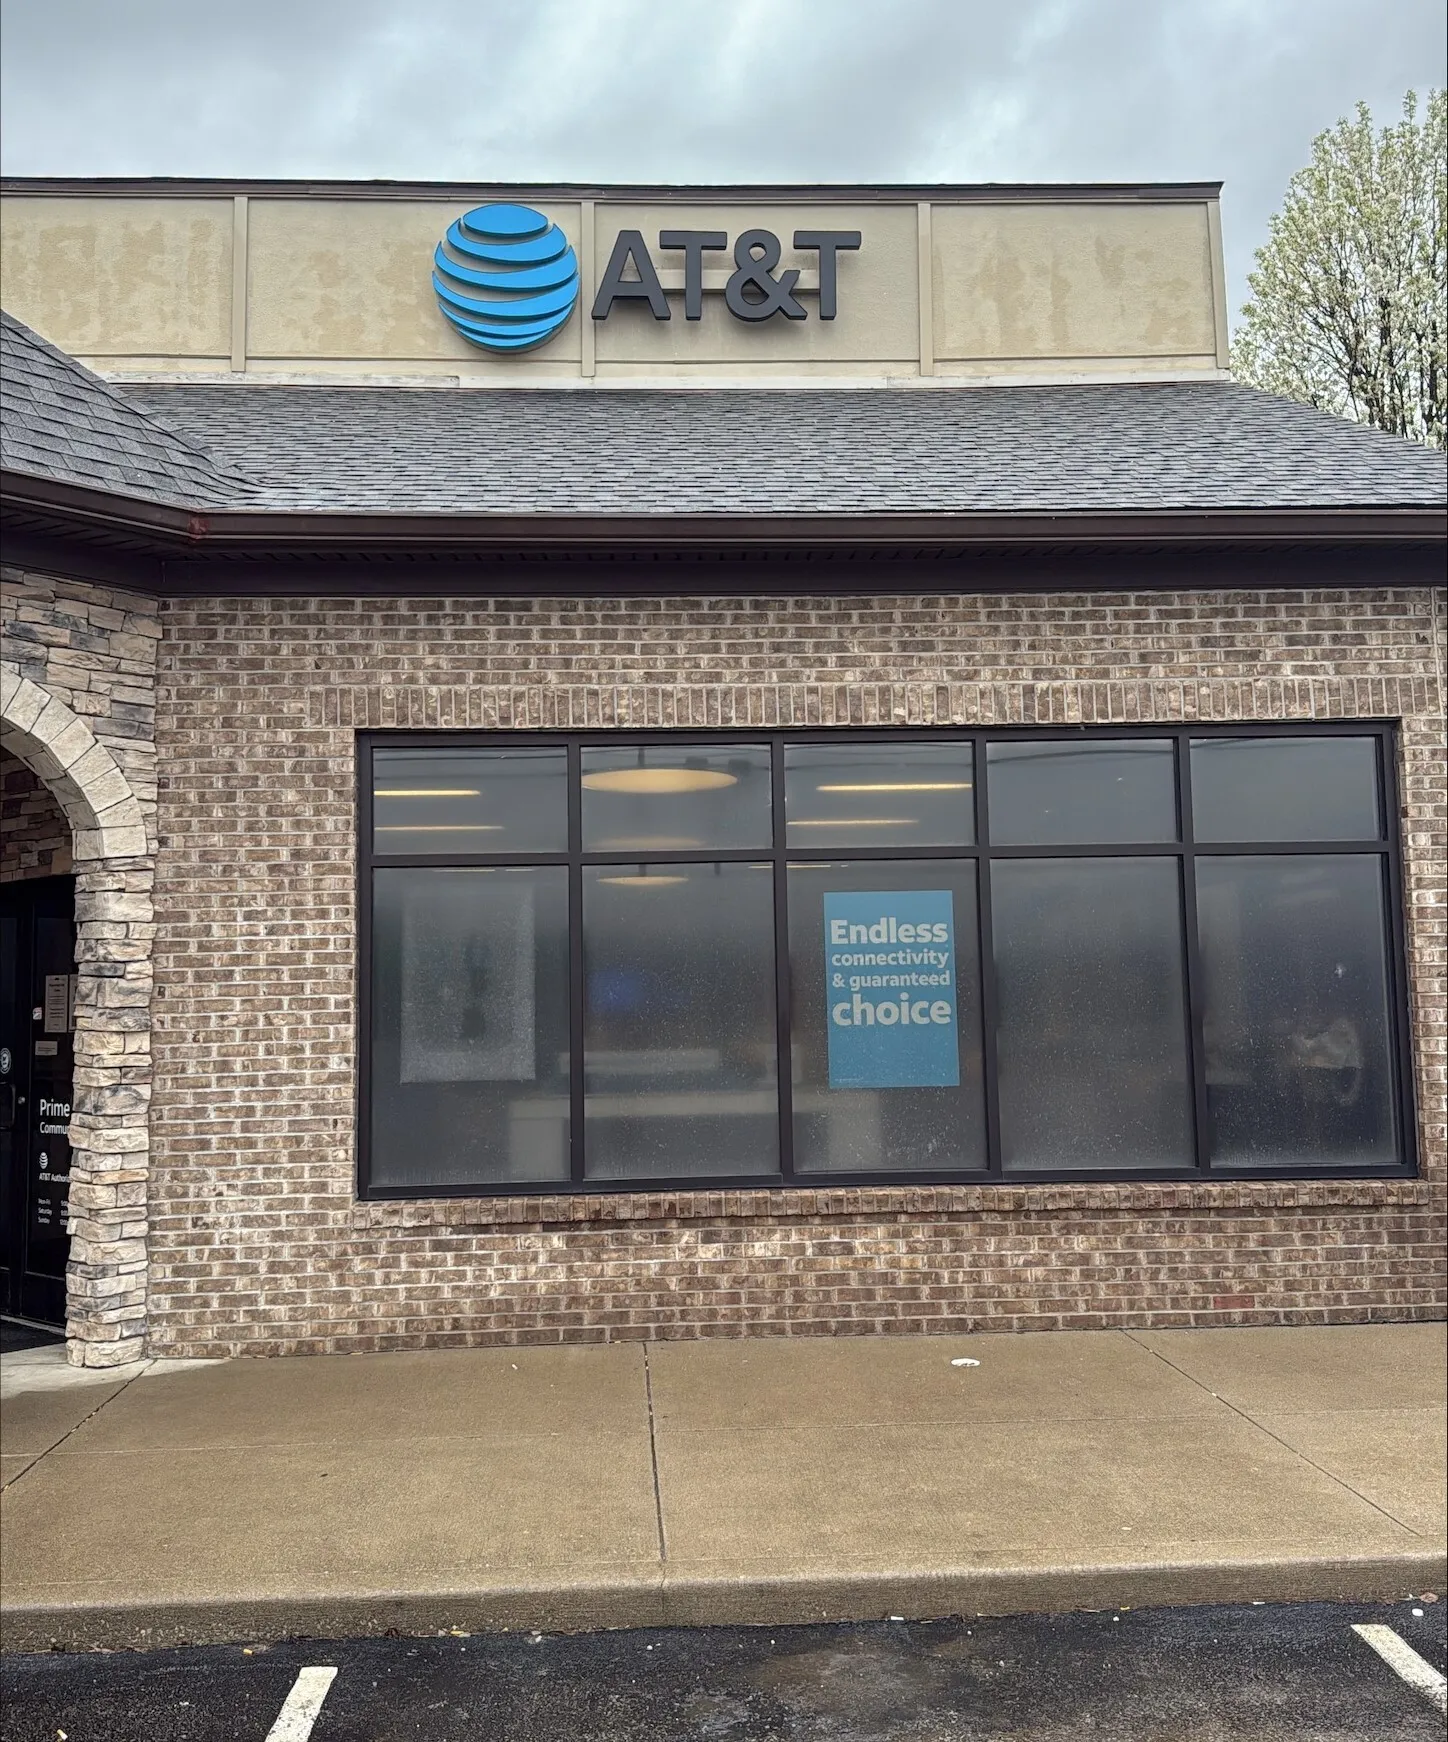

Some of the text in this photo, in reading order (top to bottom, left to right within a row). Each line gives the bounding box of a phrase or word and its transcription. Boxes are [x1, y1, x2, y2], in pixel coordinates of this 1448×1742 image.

[591, 228, 862, 322] AT&T
[830, 917, 949, 945] Endless
[831, 948, 950, 968] connectivity
[832, 970, 951, 991] & guaranteed
[832, 992, 952, 1026] choice
[39, 1098, 71, 1117] Prime
